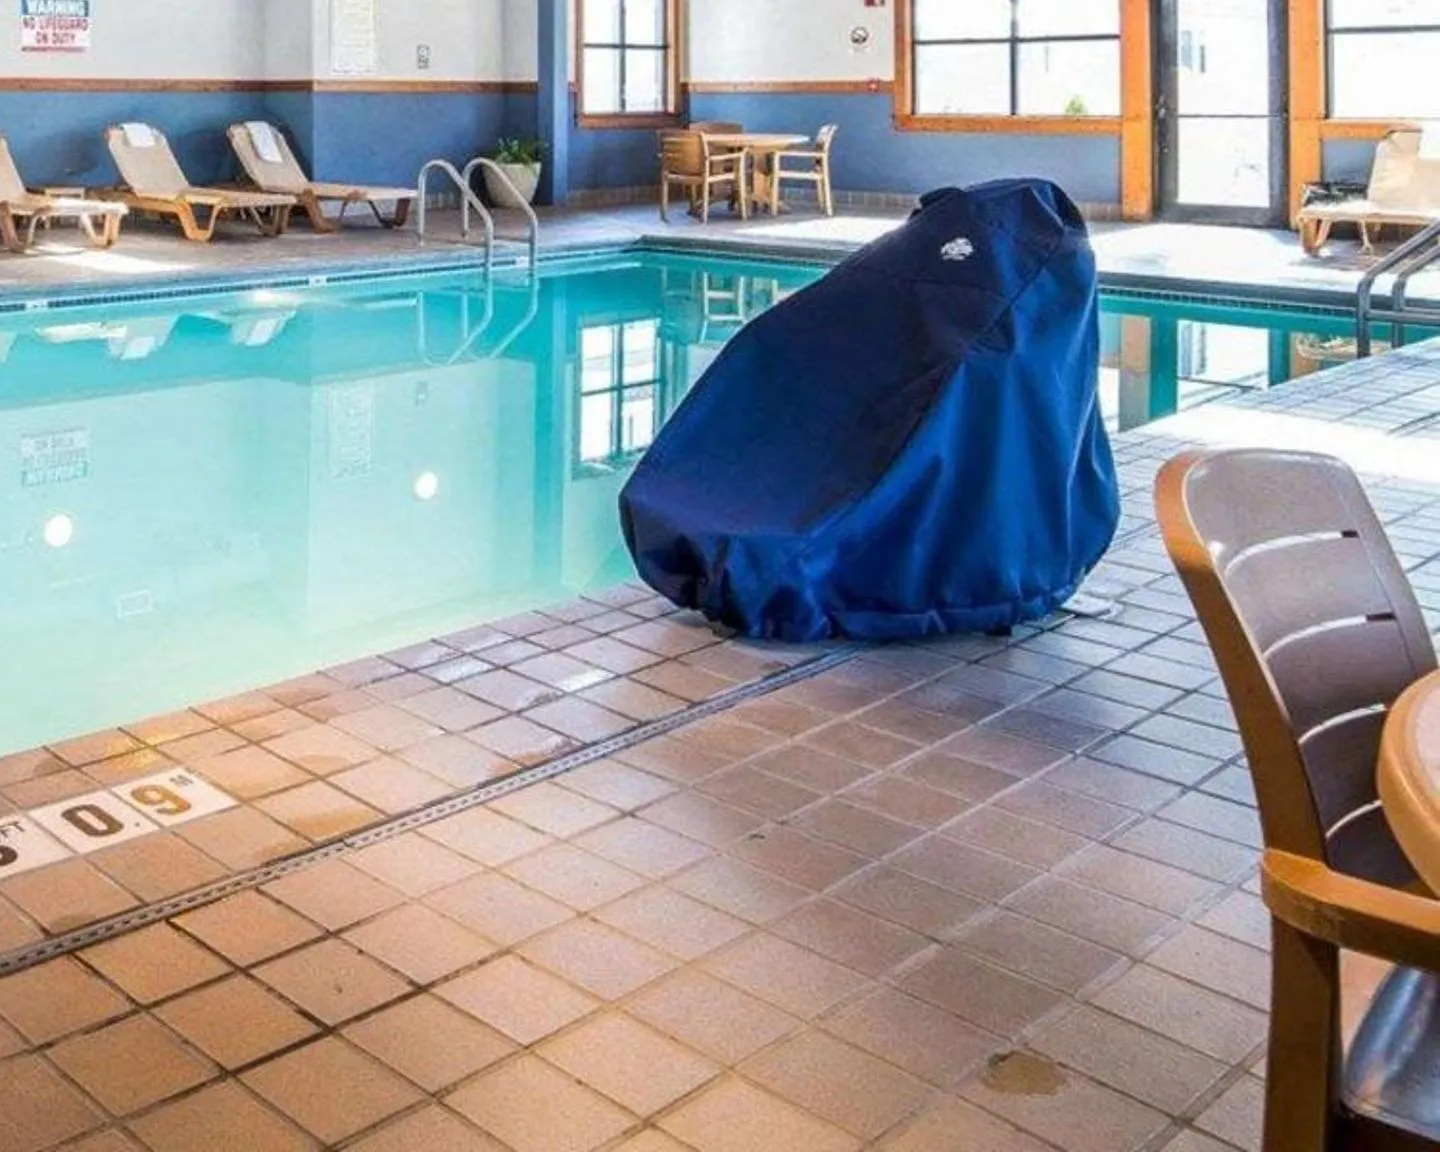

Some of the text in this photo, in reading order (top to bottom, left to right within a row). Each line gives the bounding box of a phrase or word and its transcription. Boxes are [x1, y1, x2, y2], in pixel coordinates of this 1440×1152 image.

[27, 0, 85, 16] WARNING
[22, 16, 89, 30] NO LIFEGUARD
[35, 31, 76, 44] ON DUTY
